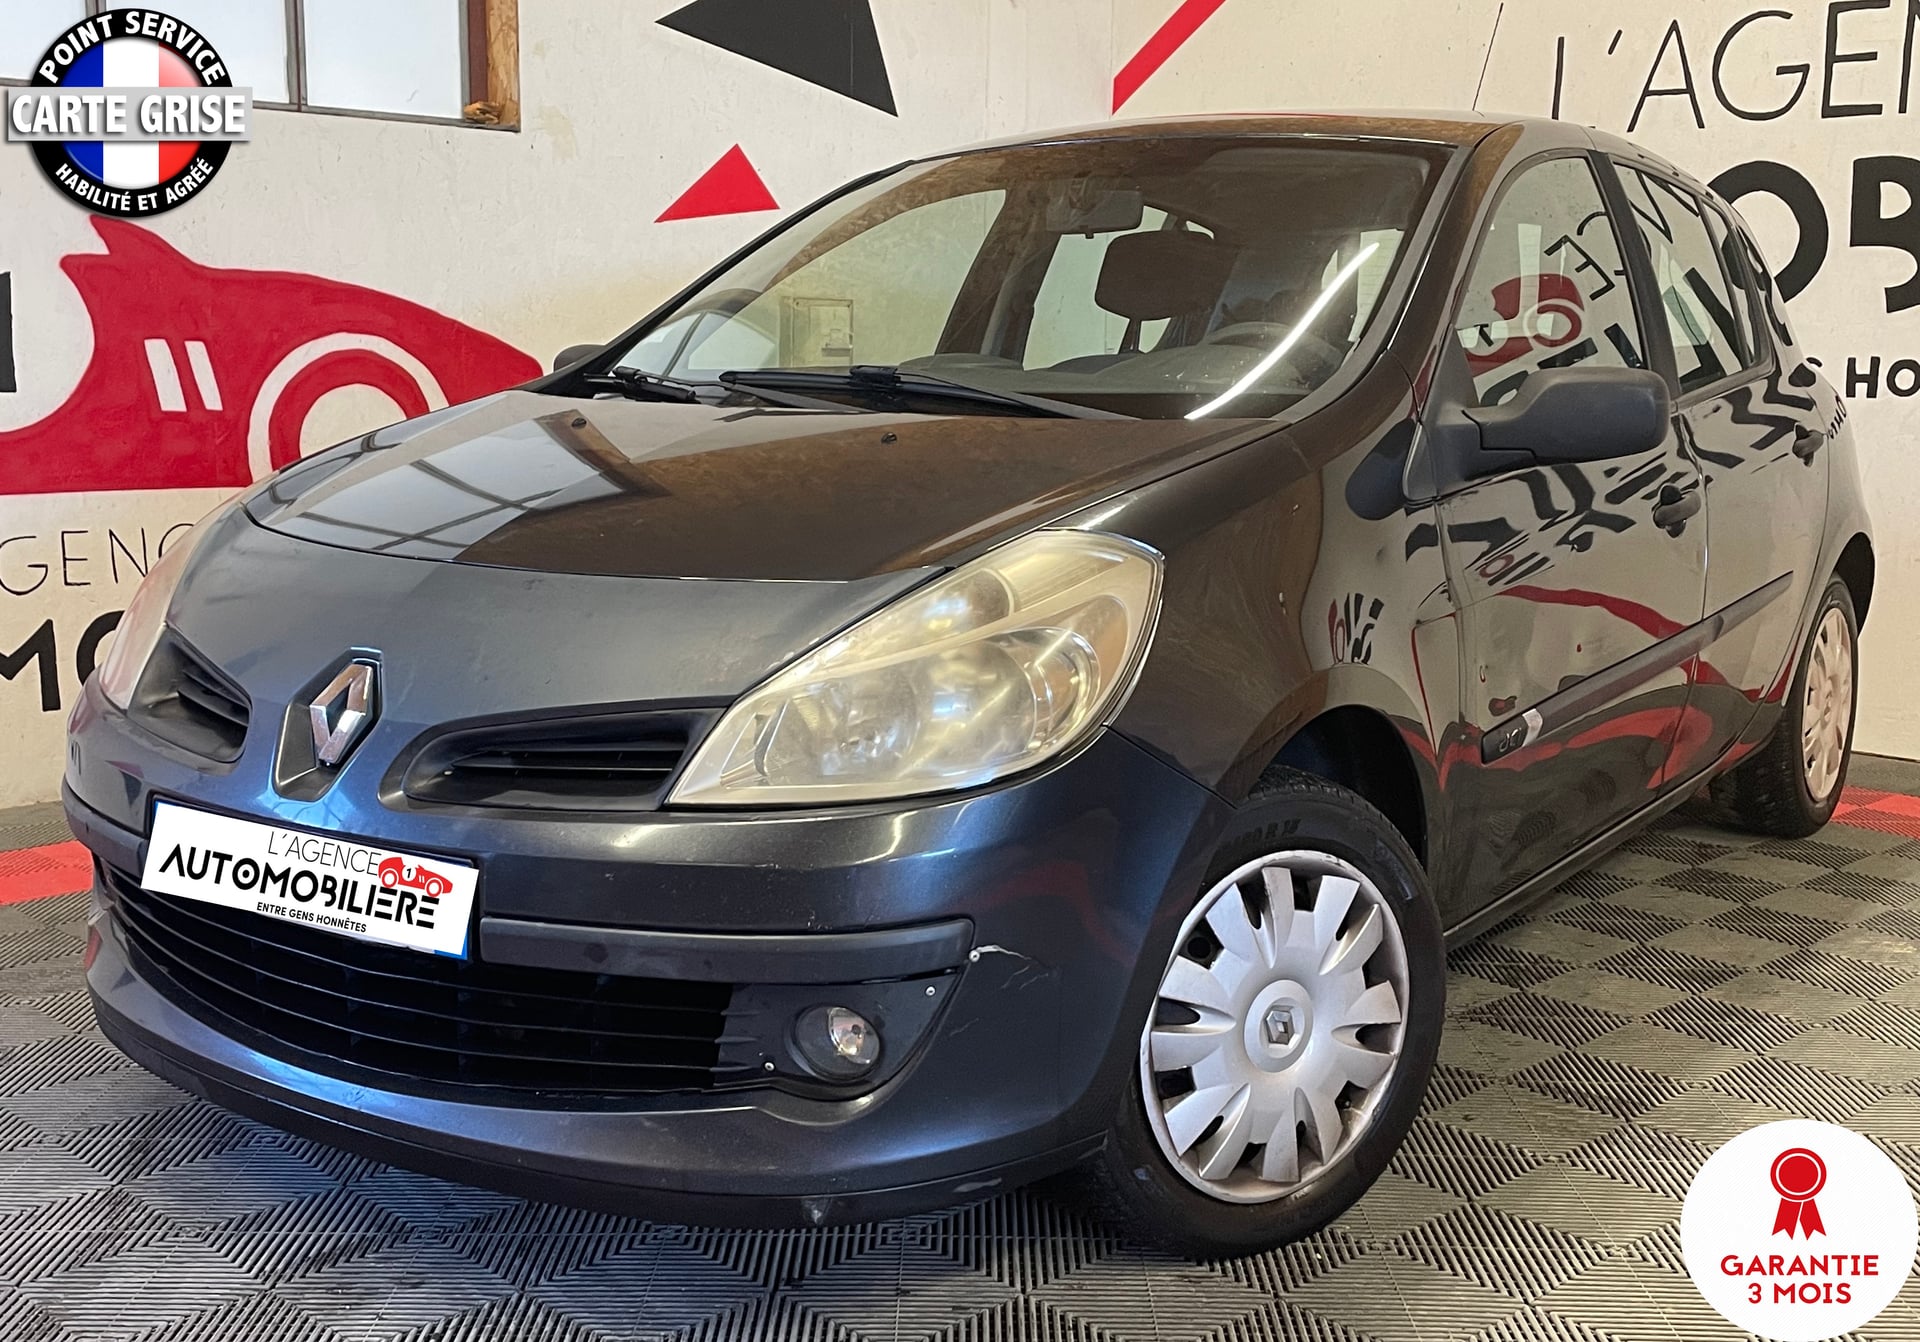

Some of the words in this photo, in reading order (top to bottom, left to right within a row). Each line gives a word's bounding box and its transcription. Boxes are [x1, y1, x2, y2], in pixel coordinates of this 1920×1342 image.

[267, 831, 382, 876] L'AGENCE
[406, 867, 412, 879] 1
[257, 902, 287, 916] ENTRE
[289, 908, 315, 922] GENS
[316, 915, 367, 933] HONNÊTES
